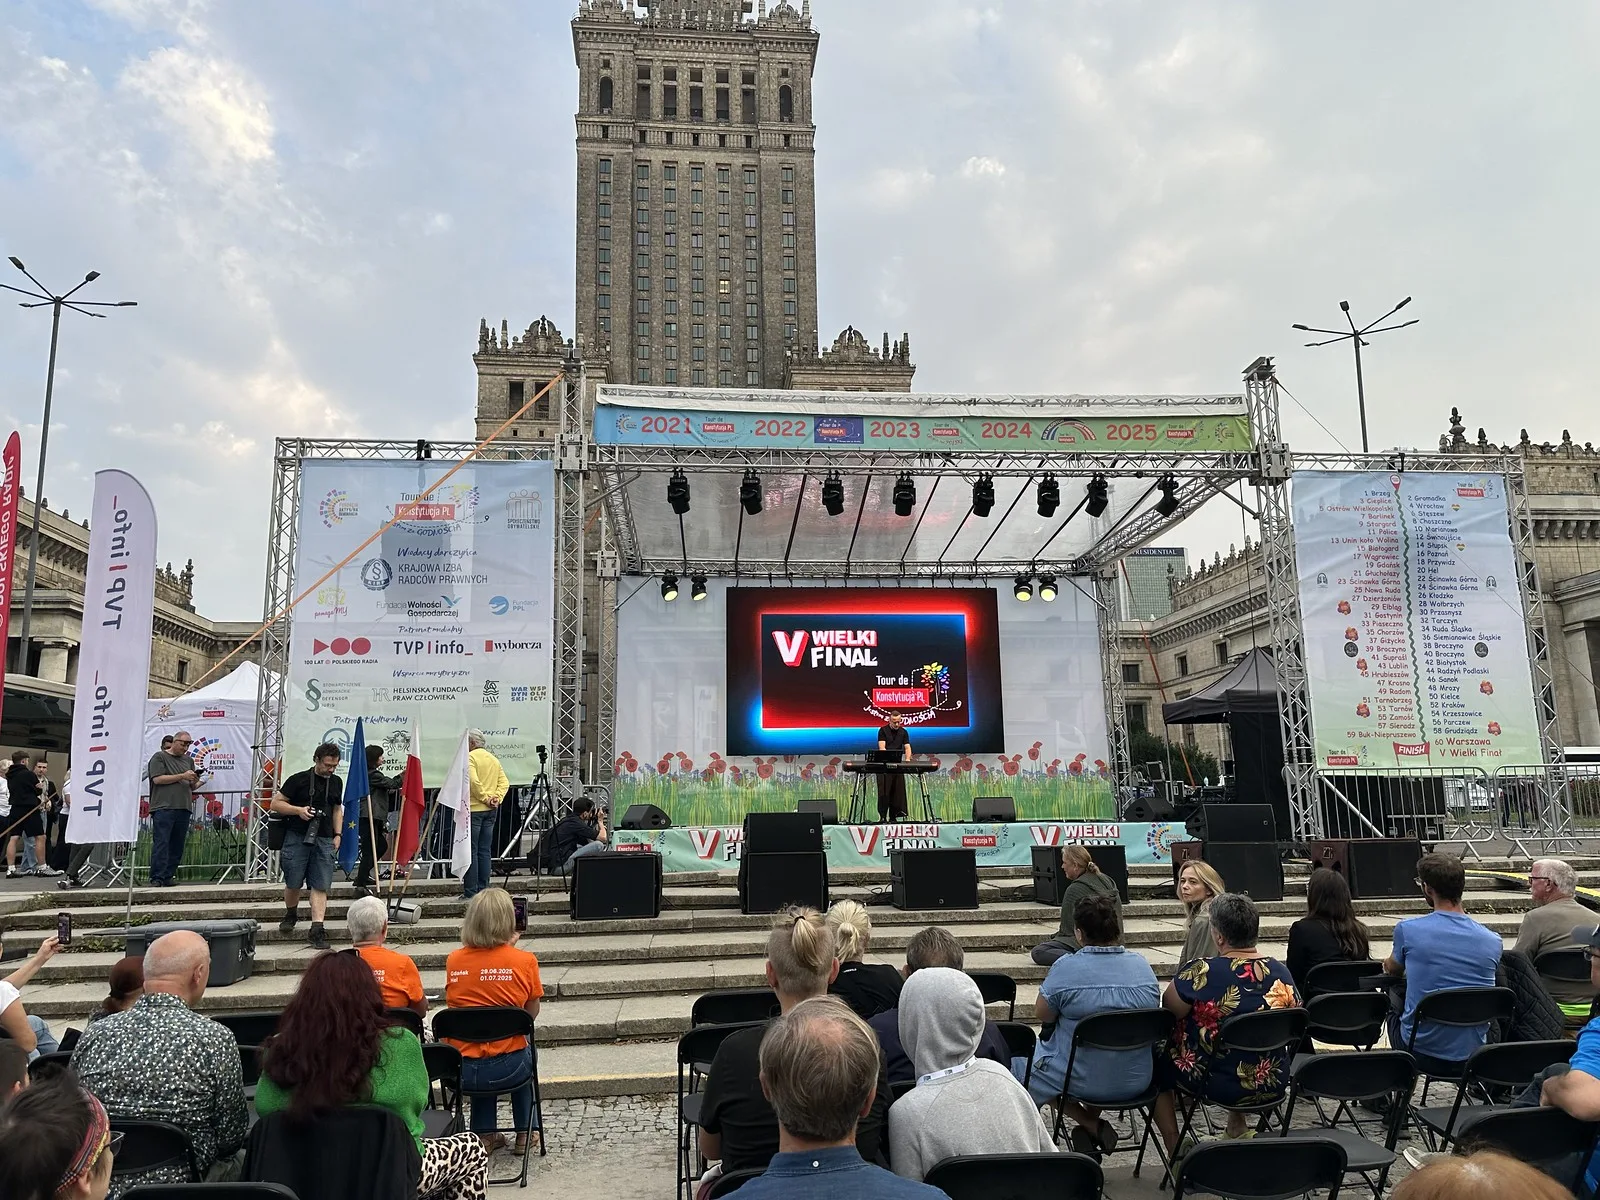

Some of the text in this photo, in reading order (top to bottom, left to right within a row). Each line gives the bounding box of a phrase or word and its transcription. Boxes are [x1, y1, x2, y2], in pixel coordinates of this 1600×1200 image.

[640, 416, 692, 434] 2021
[754, 419, 806, 437] 2022
[870, 421, 920, 438] 2023
[981, 422, 1032, 439] 2024
[1106, 424, 1157, 441] 2025
[398, 563, 462, 572] KRAJOWA IZBA
[398, 574, 487, 584] RADCÓW PRAWNYCH
[1428, 582, 1458, 591] Ścinawka
[376, 601, 407, 610] Fundacja
[408, 610, 458, 618] Gospodarczej
[393, 641, 424, 654] TVP
[494, 640, 542, 652] wyborcza
[772, 630, 877, 666] V WIELKI
[811, 647, 878, 668] FINAŁ
[876, 675, 908, 685] Tour de
[876, 691, 924, 704] Konstytucja PL
[507, 728, 518, 736] IT
[1358, 731, 1416, 739] Buk-Niepruszewo
[1444, 727, 1478, 735] Grudziądz
[1398, 745, 1425, 755] FINISH
[1480, 748, 1502, 757] Finał
[849, 825, 880, 856] V
[882, 825, 939, 838] WIELKI
[1030, 825, 1061, 846] V
[1064, 825, 1120, 838] WIELKI
[688, 829, 721, 860] V
